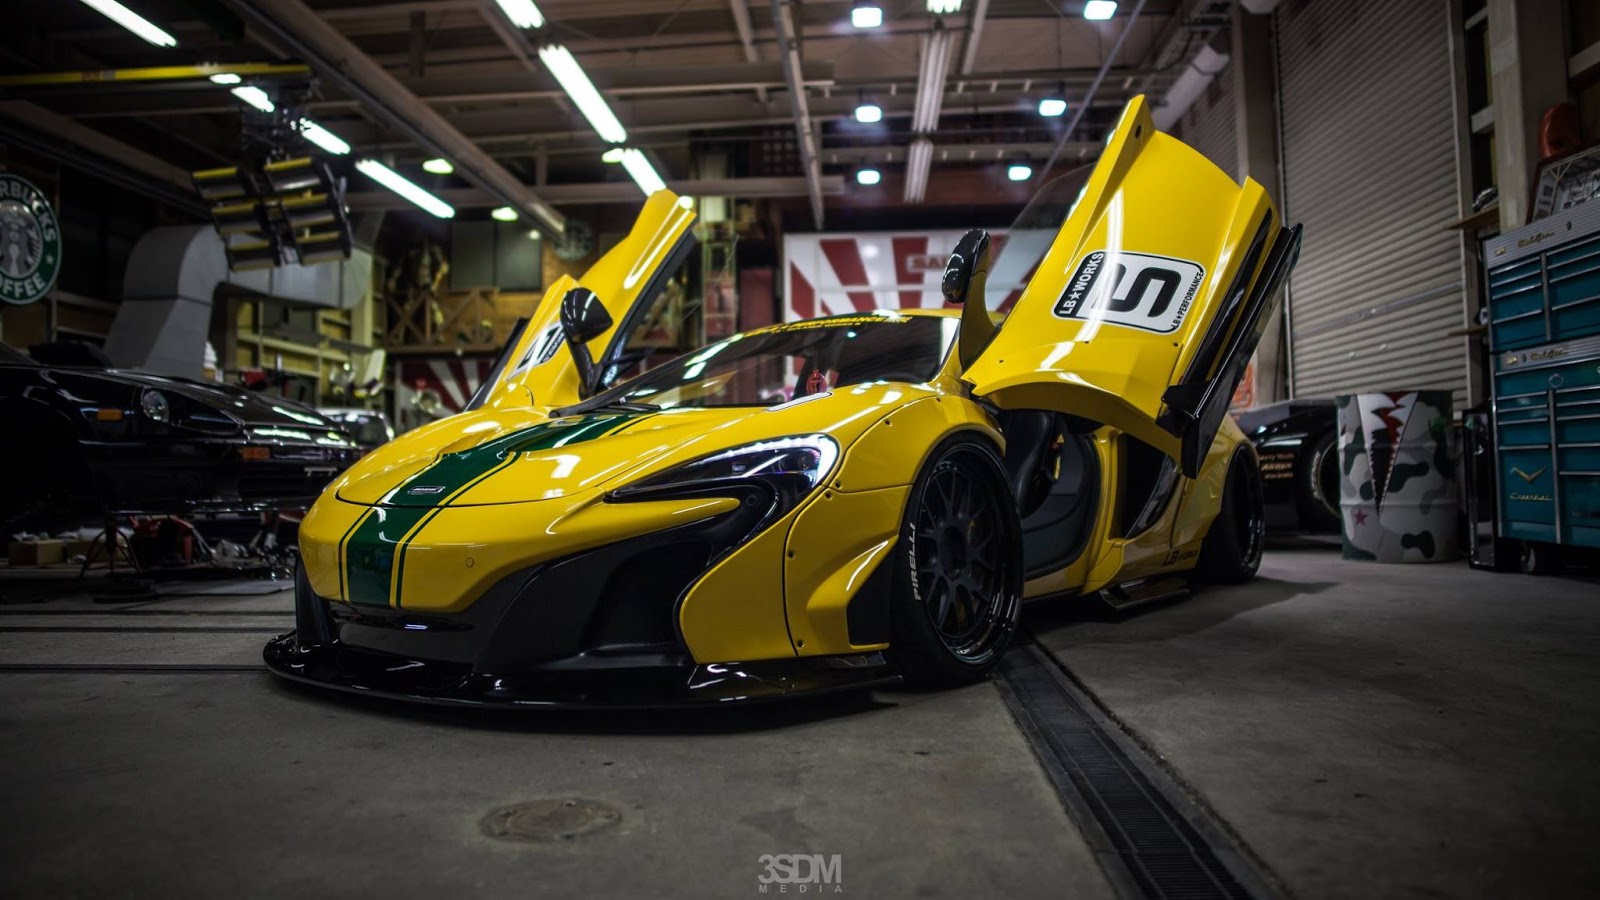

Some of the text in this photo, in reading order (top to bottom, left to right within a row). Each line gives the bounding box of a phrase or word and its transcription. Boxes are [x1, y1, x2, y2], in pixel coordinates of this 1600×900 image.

[0, 180, 57, 242] RBUCKS
[0, 272, 46, 298] FFEE
[909, 522, 922, 600] PIRELLI
